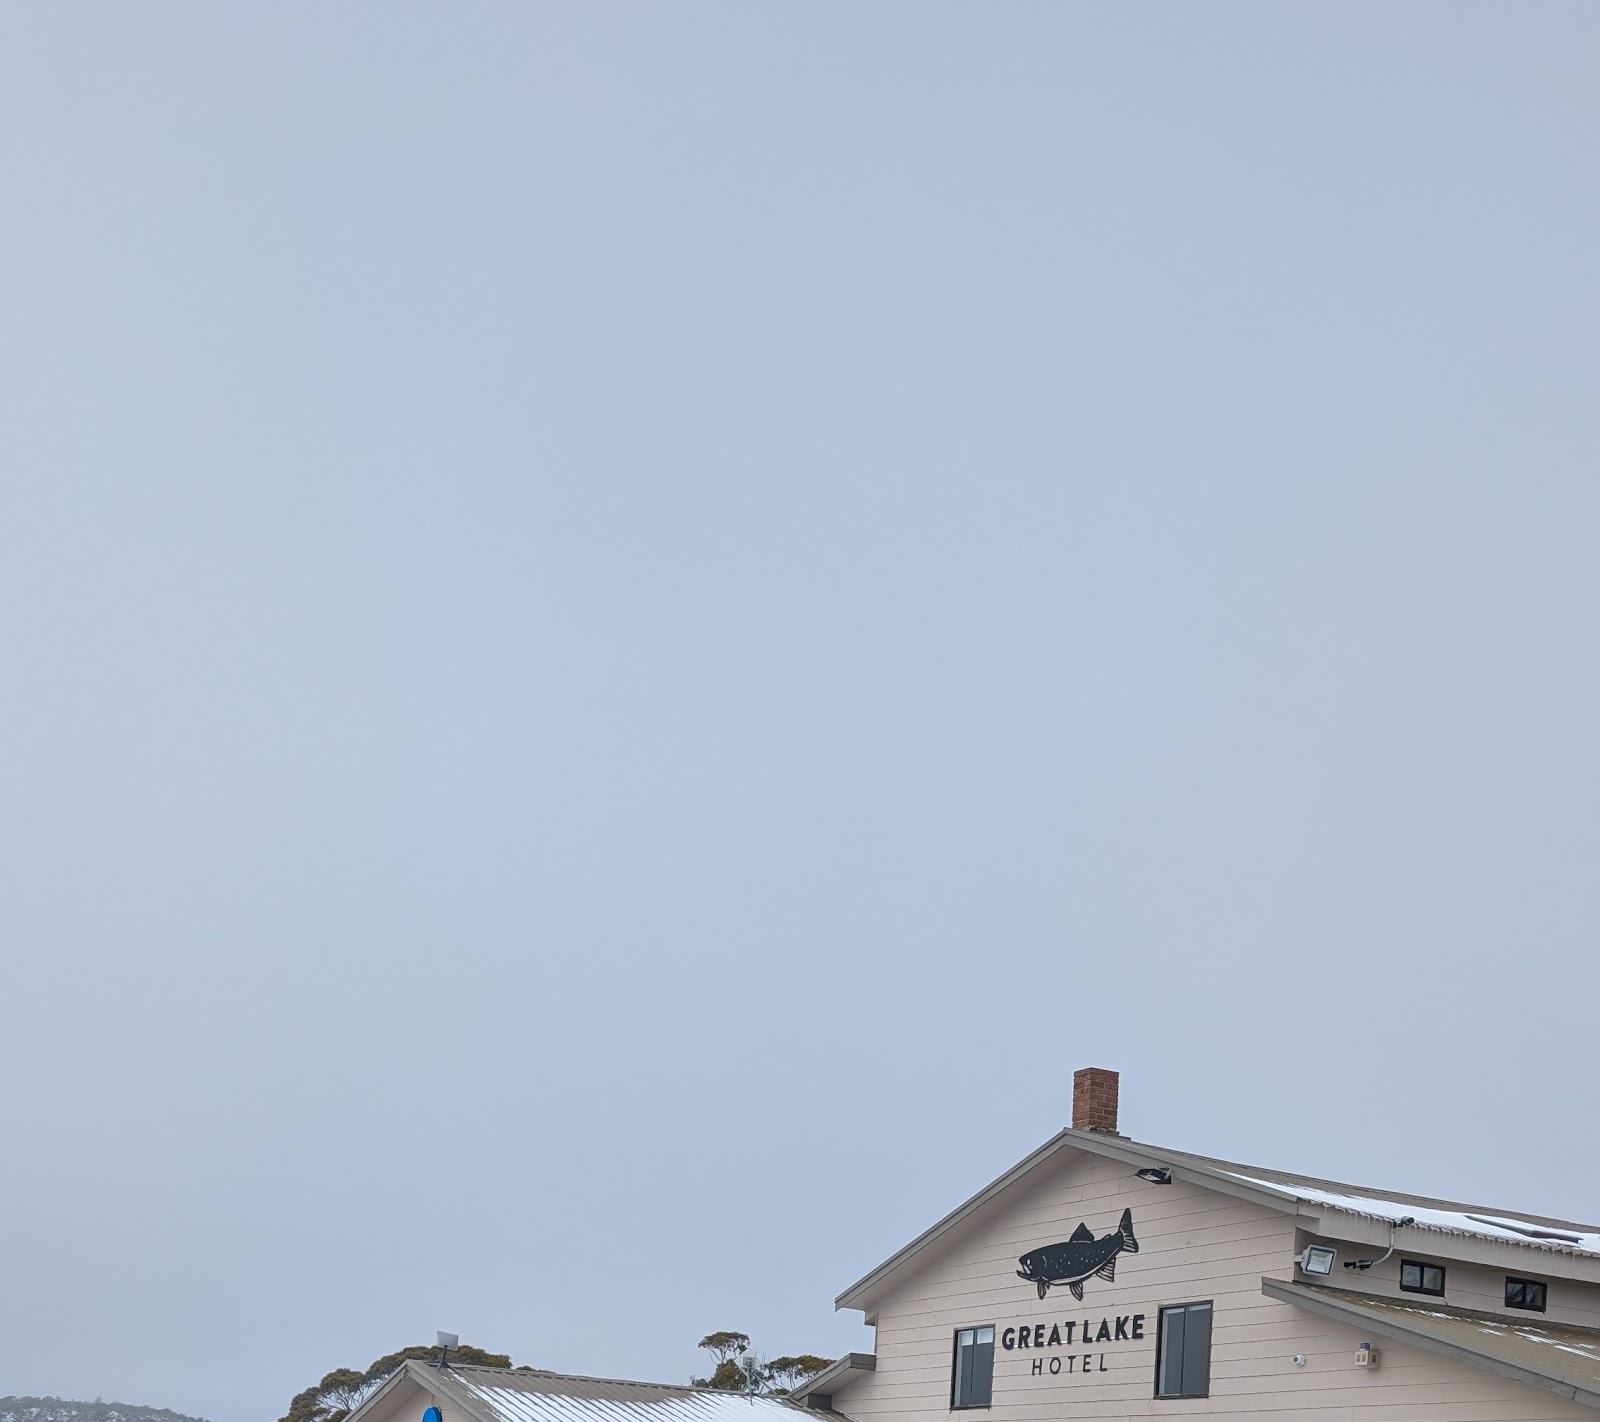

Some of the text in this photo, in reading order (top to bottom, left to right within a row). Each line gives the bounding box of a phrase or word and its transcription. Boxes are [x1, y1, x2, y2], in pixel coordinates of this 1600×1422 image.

[1002, 1314, 1145, 1350] GREAT LAKE
[1031, 1353, 1108, 1376] HOTEL
